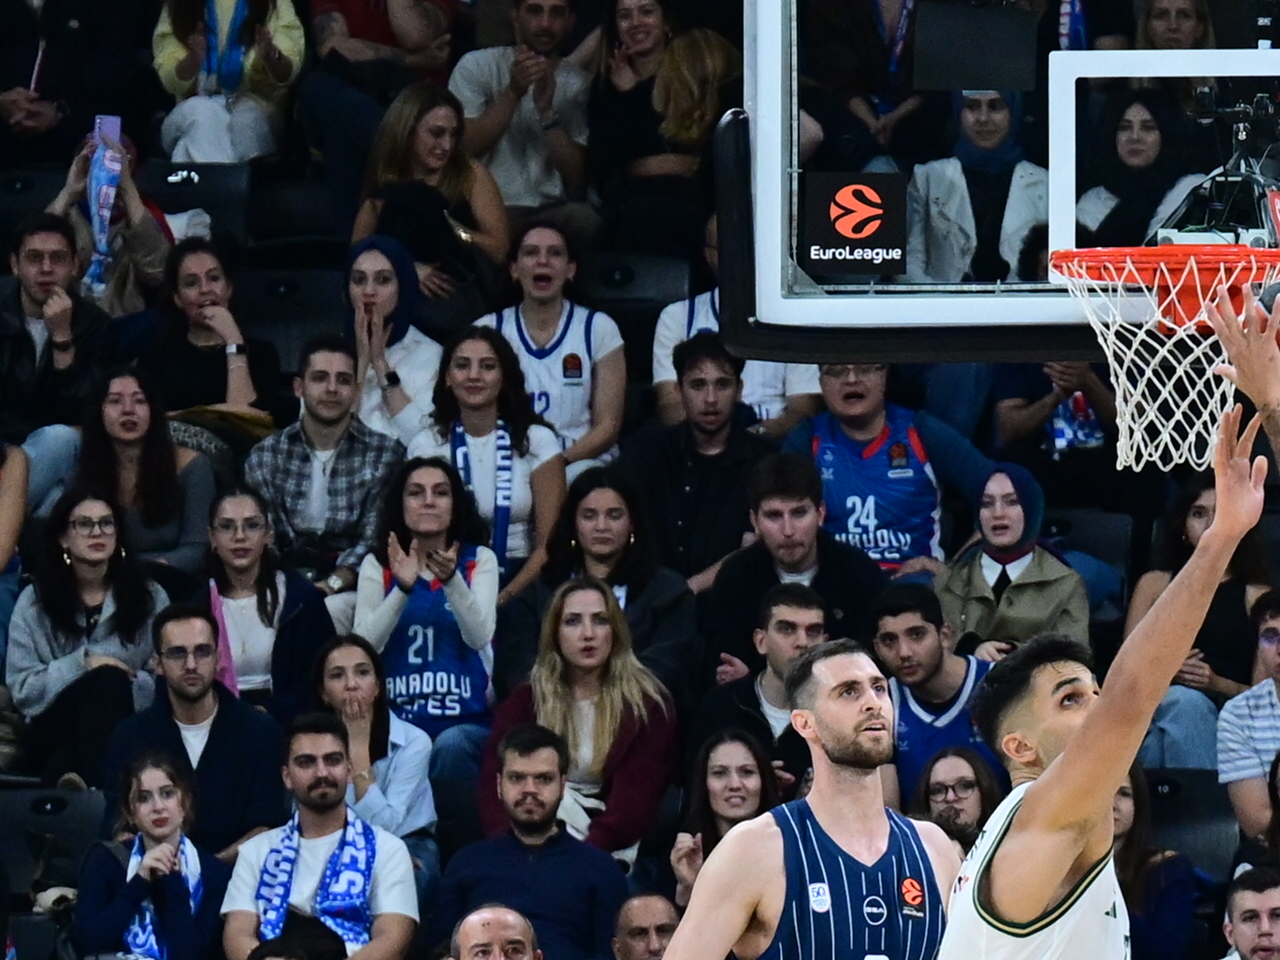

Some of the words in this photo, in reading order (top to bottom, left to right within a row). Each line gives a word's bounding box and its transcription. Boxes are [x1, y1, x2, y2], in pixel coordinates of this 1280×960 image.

[810, 245, 902, 264] EuroLeague
[845, 495, 879, 534] 24
[407, 624, 435, 665] 21
[385, 671, 472, 700] ANADOLU
